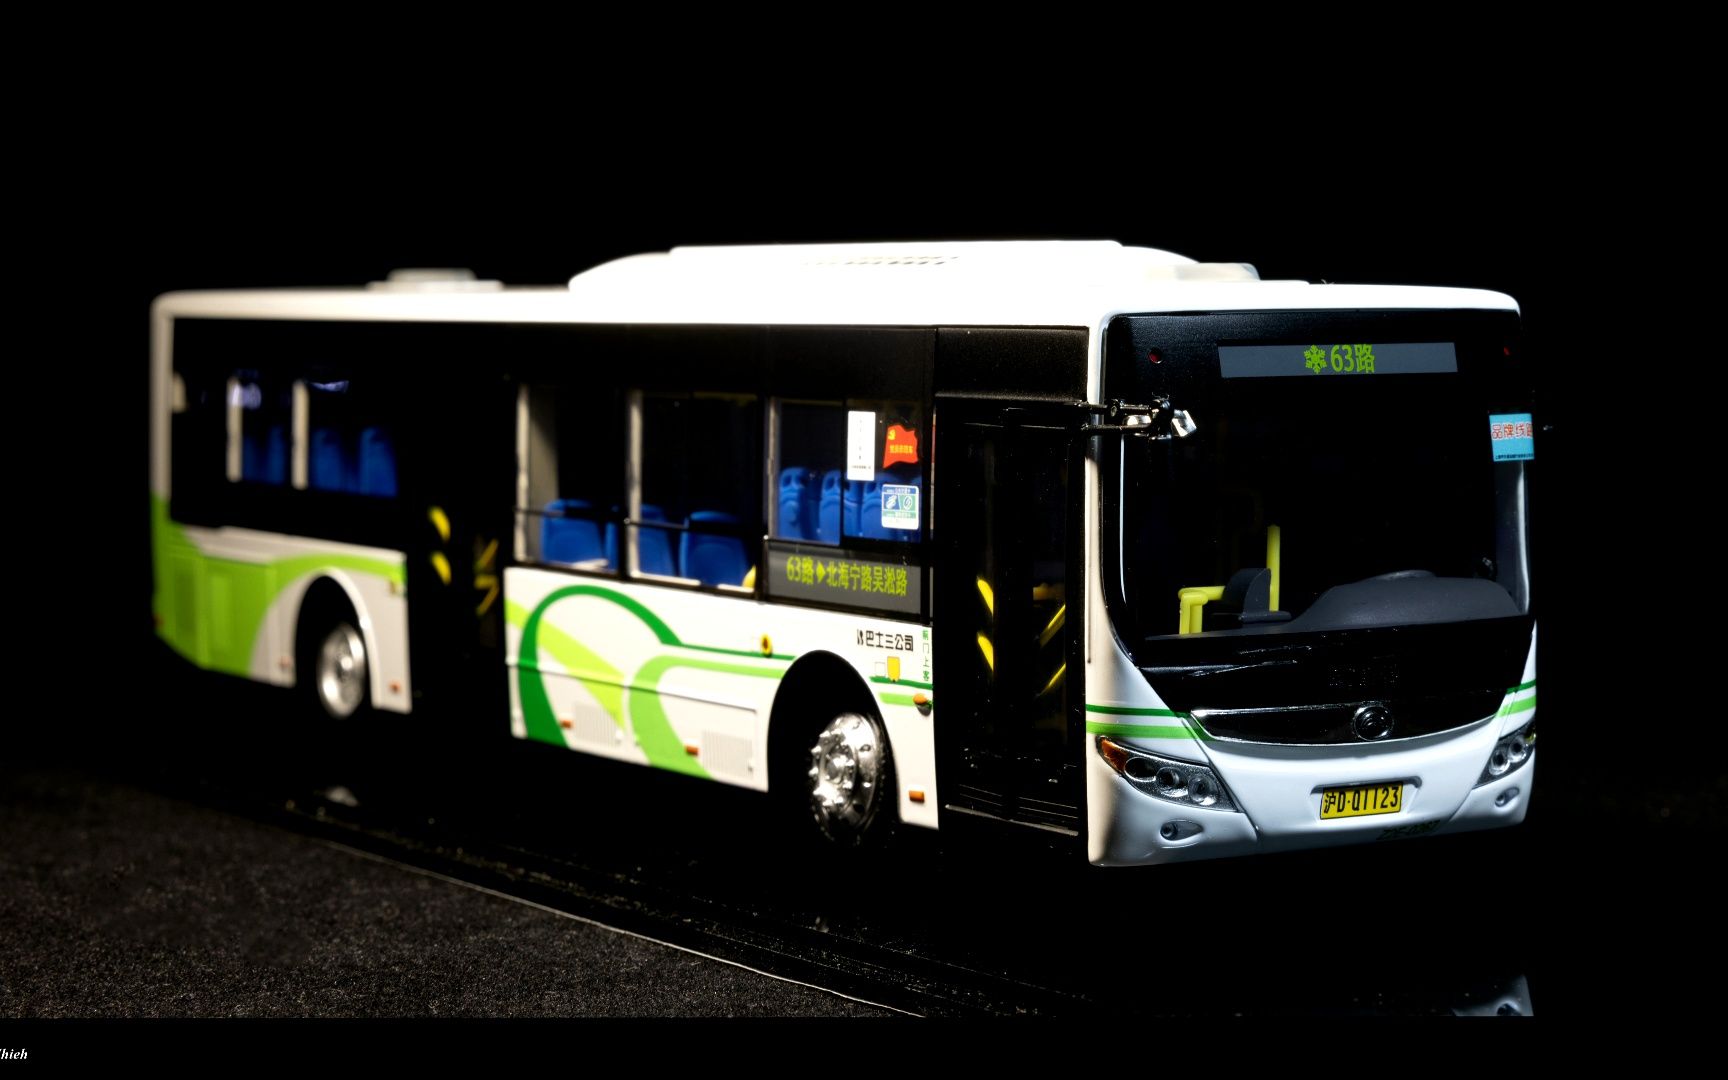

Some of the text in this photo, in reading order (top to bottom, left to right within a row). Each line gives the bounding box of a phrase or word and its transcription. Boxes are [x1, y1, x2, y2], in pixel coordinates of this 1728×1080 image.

[1330, 344, 1375, 373] 63路
[786, 555, 814, 585] 63路
[865, 629, 914, 652] 巴士三公司
